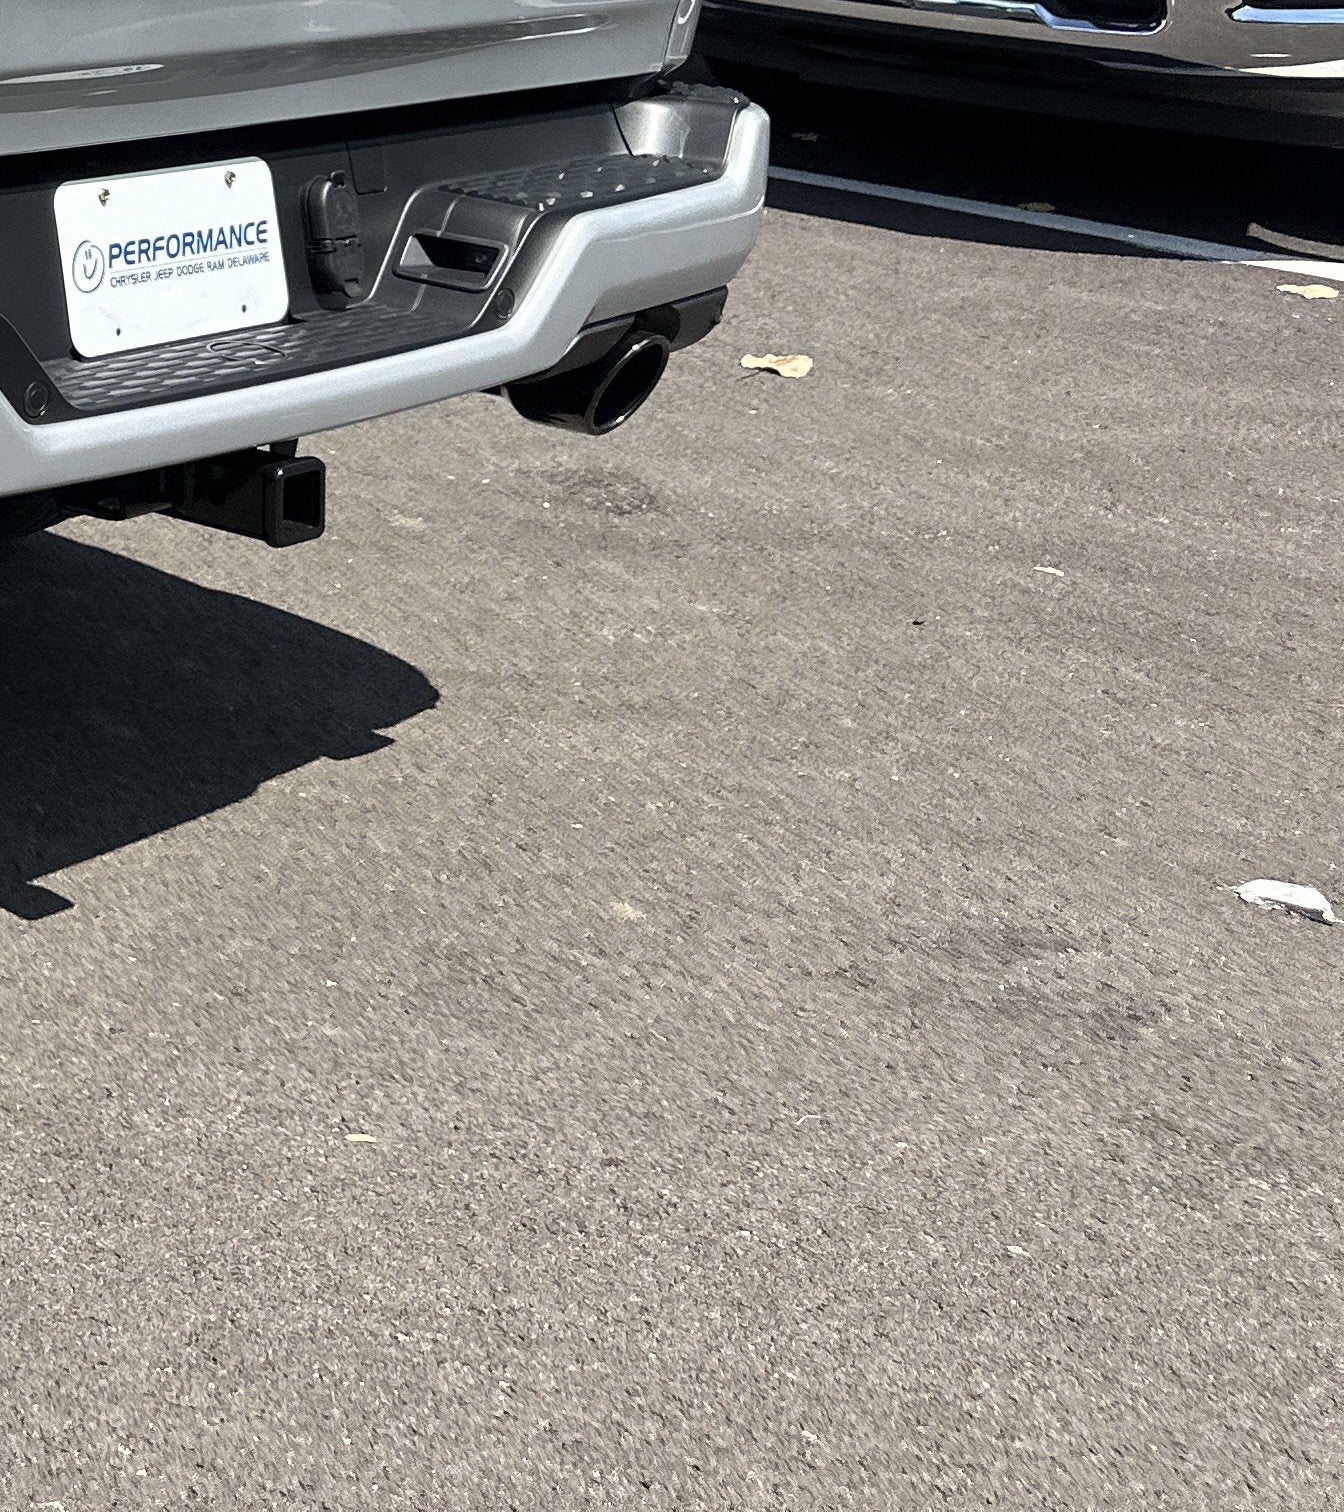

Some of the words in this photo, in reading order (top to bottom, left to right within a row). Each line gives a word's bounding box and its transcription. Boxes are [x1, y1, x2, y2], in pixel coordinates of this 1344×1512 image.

[108, 220, 268, 268] PERFORMANCE
[110, 271, 152, 288] CHRYSLER
[154, 267, 174, 281] JEEP
[177, 262, 204, 277] DODGE
[207, 258, 225, 271] RAM
[227, 250, 270, 268] DELAWARE
